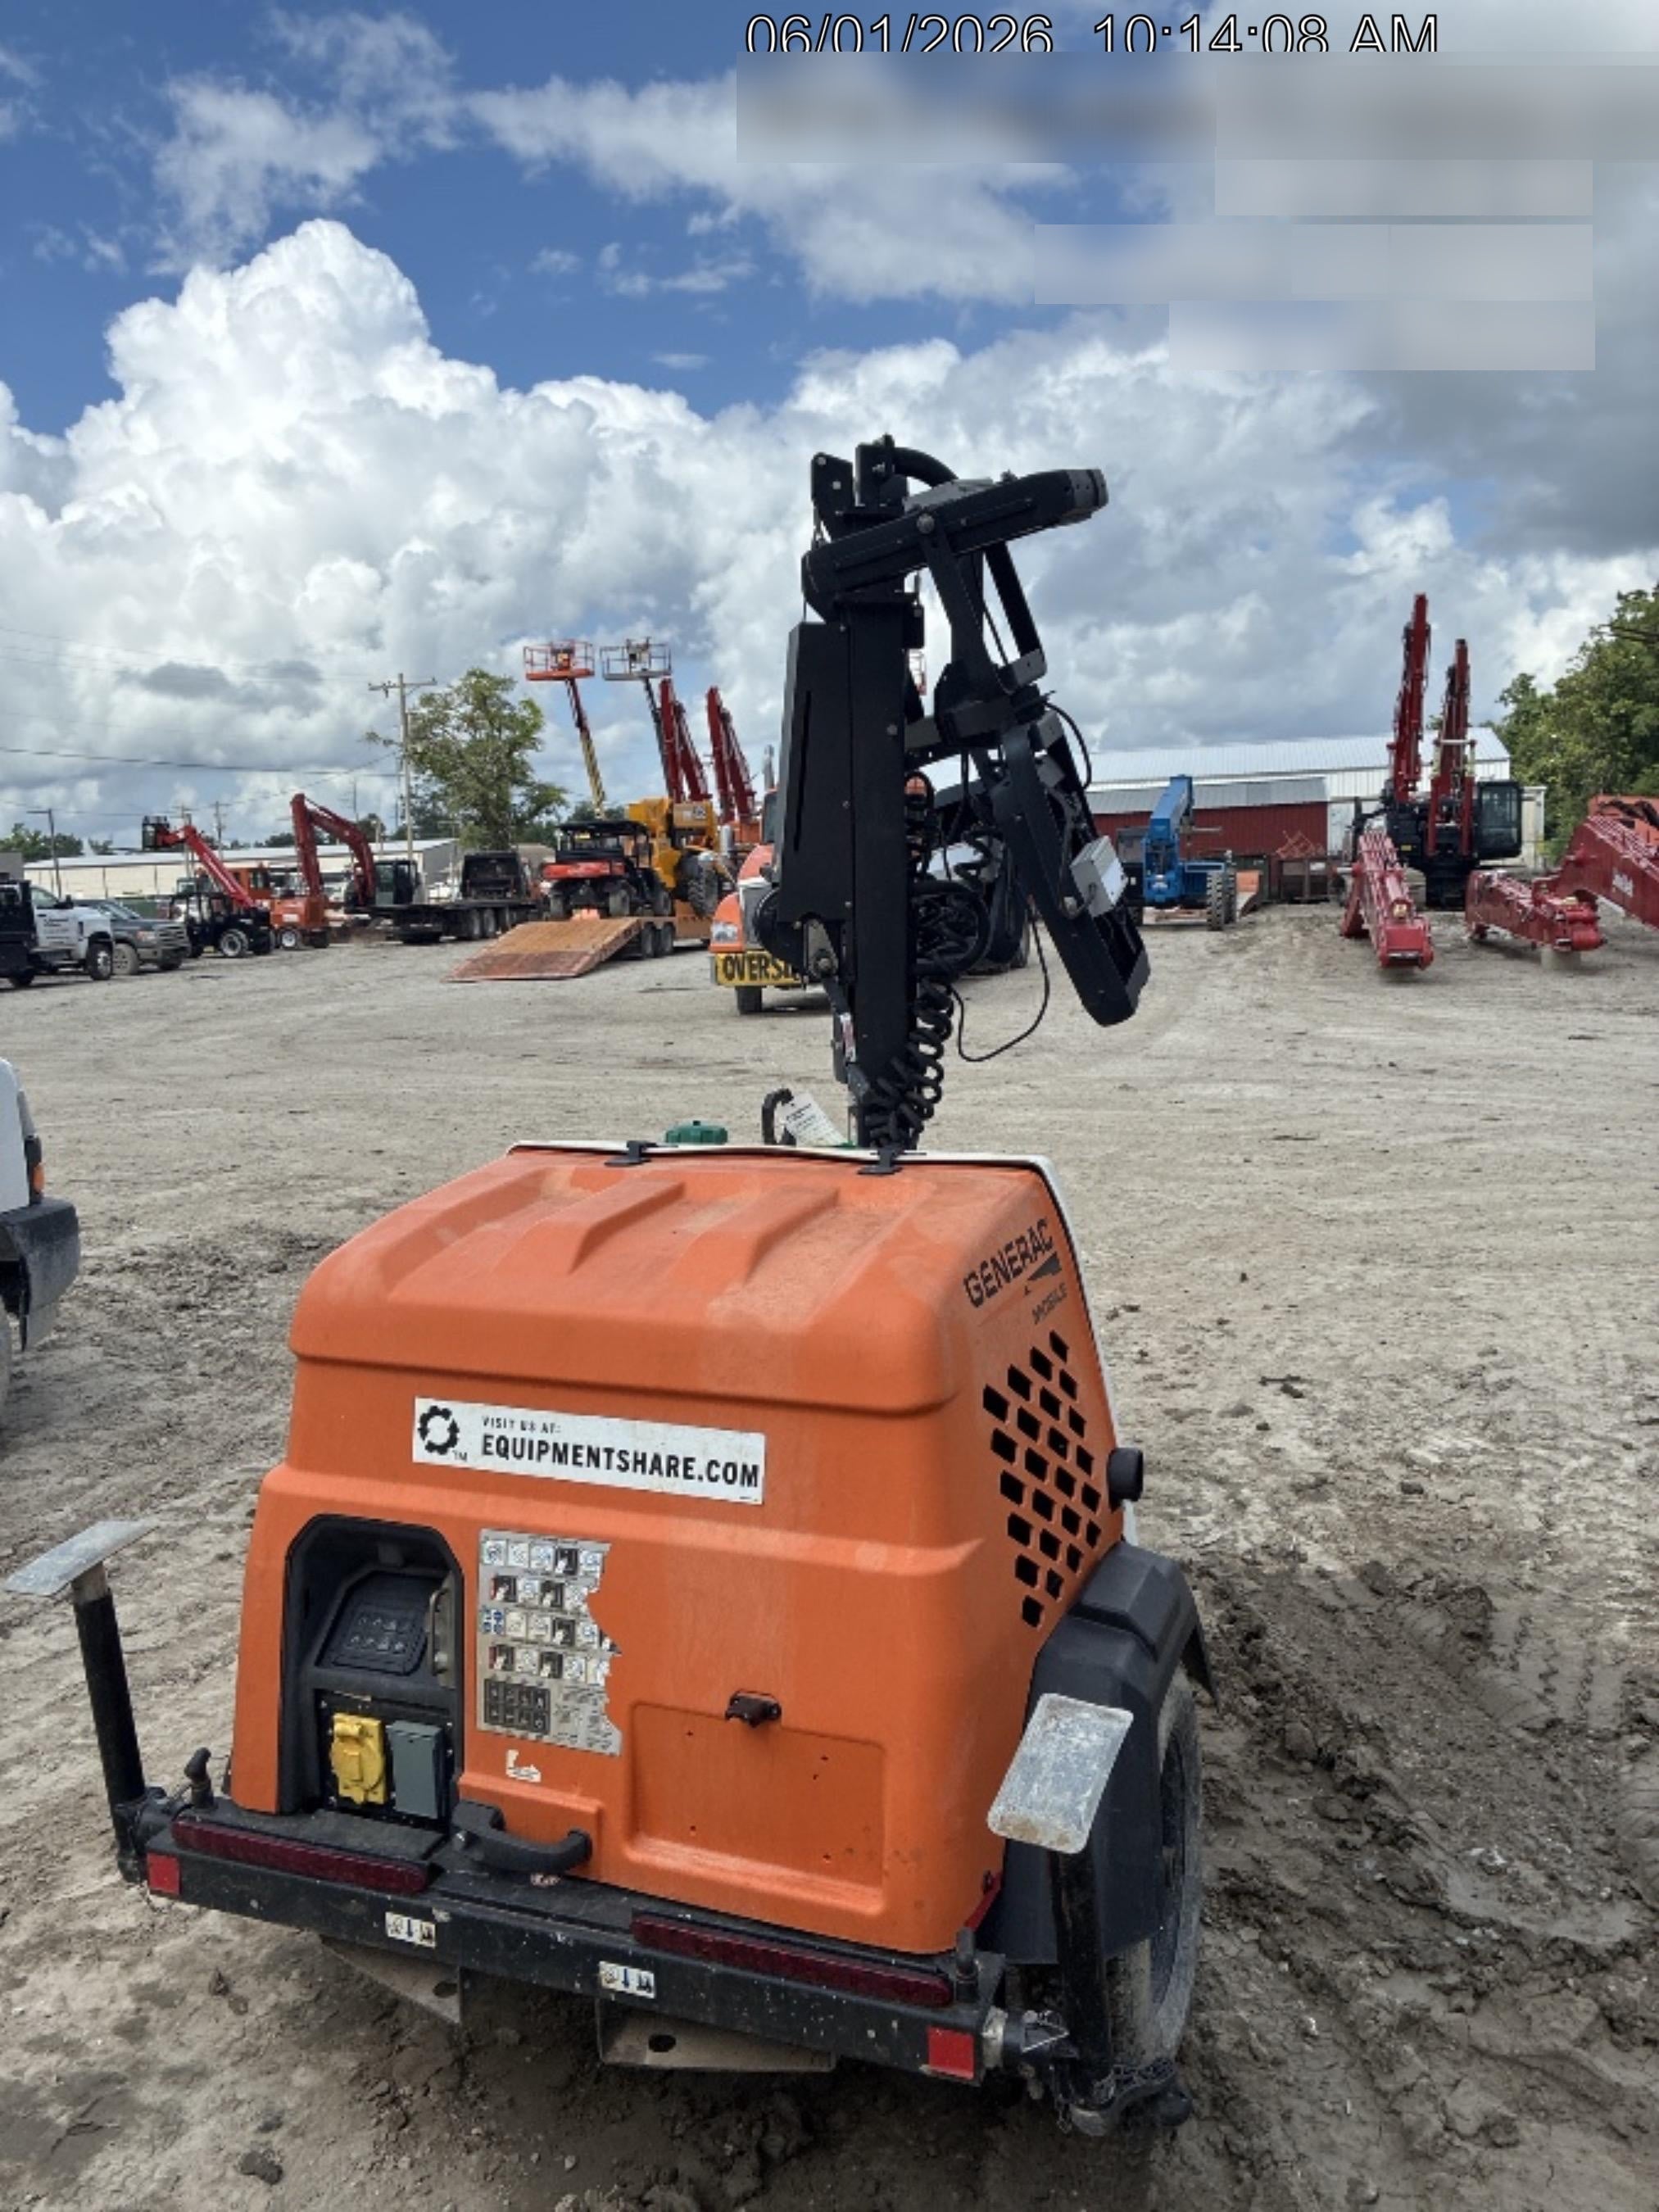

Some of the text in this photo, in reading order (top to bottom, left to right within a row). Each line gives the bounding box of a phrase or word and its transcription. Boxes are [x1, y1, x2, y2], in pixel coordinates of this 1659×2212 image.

[963, 1217, 1054, 1308] GENERAC
[482, 1416, 514, 1430] VISIT
[520, 1420, 537, 1431] US
[452, 1450, 468, 1462] TM
[482, 1434, 759, 1488] EQUIPMENTSHARE.COM
